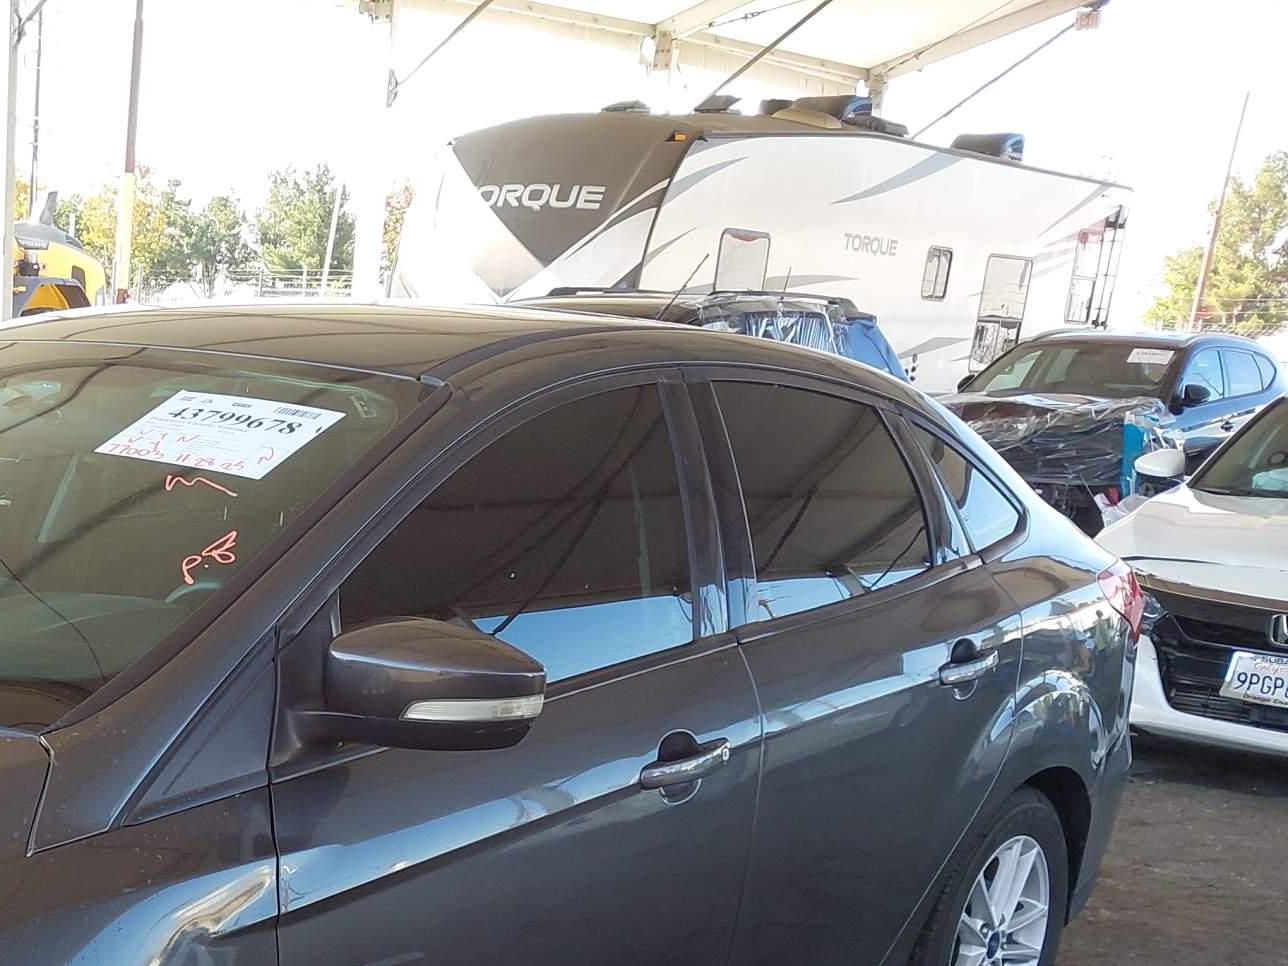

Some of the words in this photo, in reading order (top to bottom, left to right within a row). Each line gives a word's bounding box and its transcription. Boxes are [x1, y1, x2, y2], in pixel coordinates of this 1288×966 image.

[478, 183, 606, 211] ORQUE
[844, 232, 898, 256] TORQUE
[168, 406, 302, 434] 43799678
